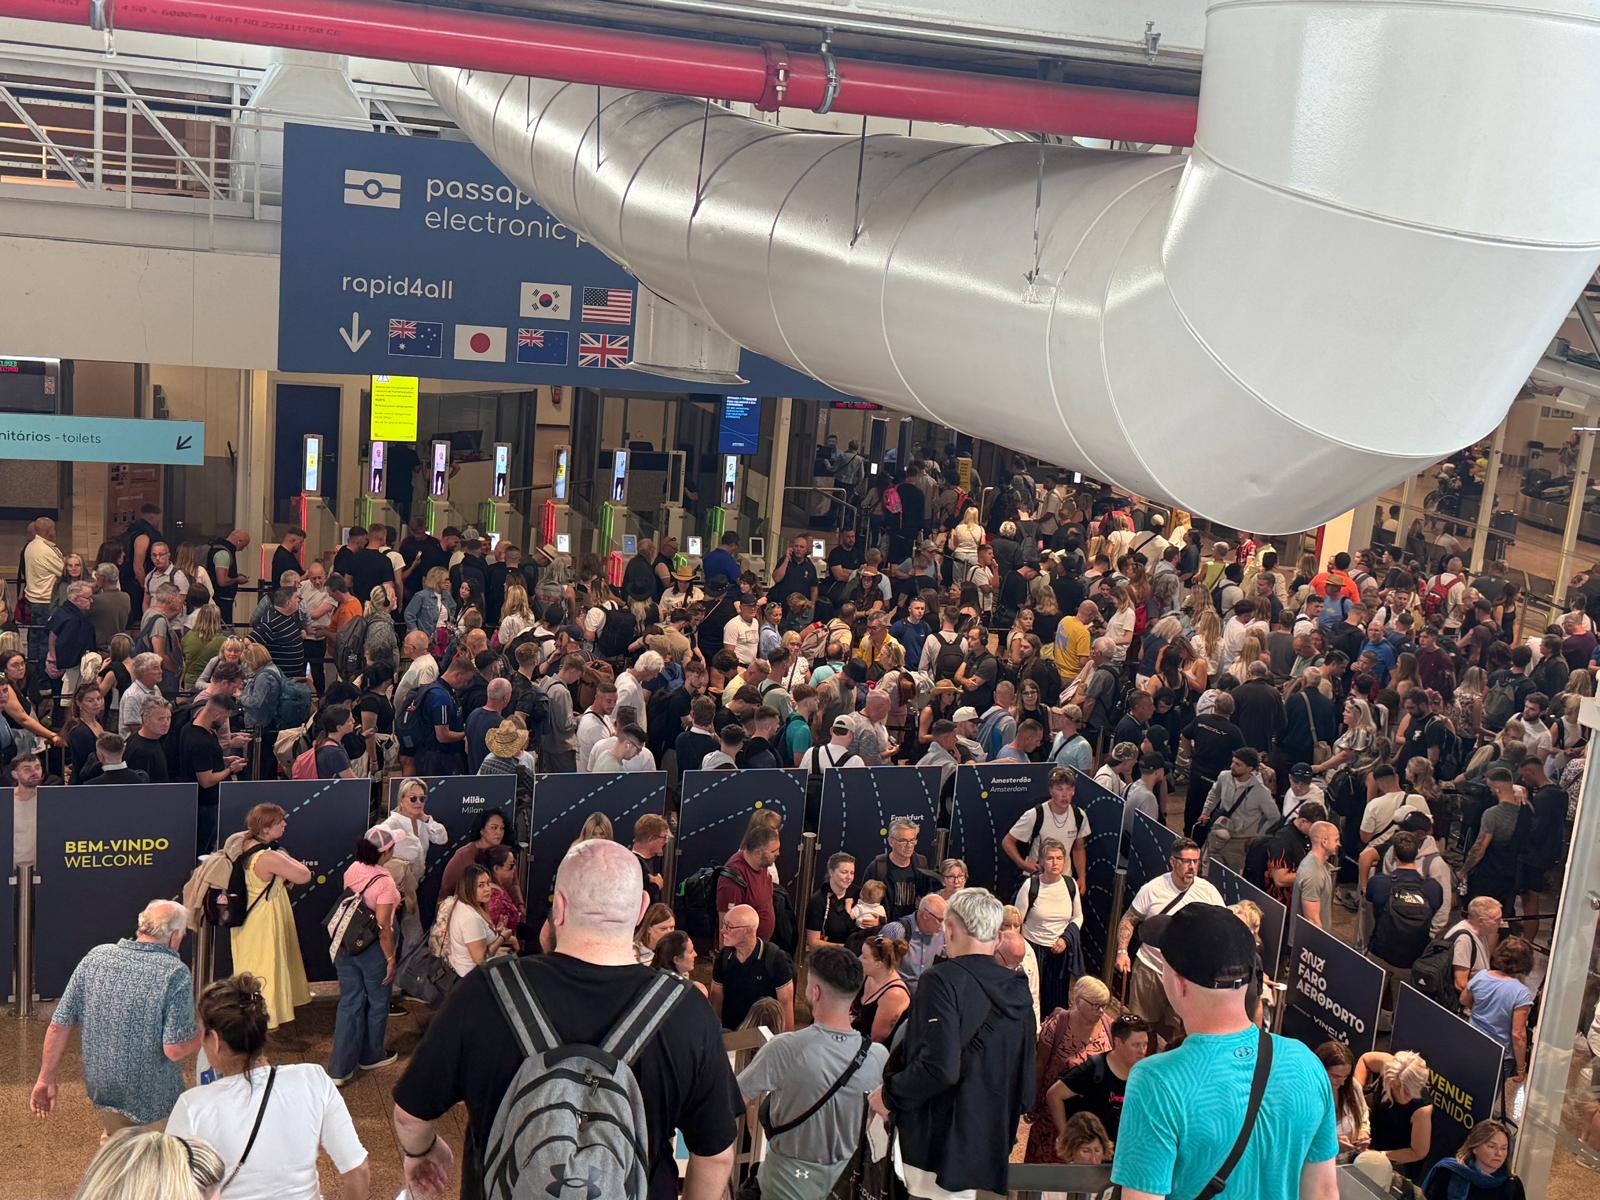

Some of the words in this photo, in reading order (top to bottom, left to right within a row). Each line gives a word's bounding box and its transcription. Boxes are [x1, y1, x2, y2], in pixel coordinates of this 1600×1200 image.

[426, 178, 539, 210] passap
[425, 206, 566, 240] electronic
[342, 275, 453, 299] rapid4all
[0, 430, 51, 442] nitários
[62, 433, 102, 444] toilets
[65, 837, 169, 853] BEM-VINDO
[64, 853, 154, 868] WELCOME
[1298, 963, 1327, 991] FARO
[1296, 979, 1365, 1033] AEROPORTO
[1313, 1015, 1338, 1037] VINCI
[1428, 1068, 1474, 1111] VENUE
